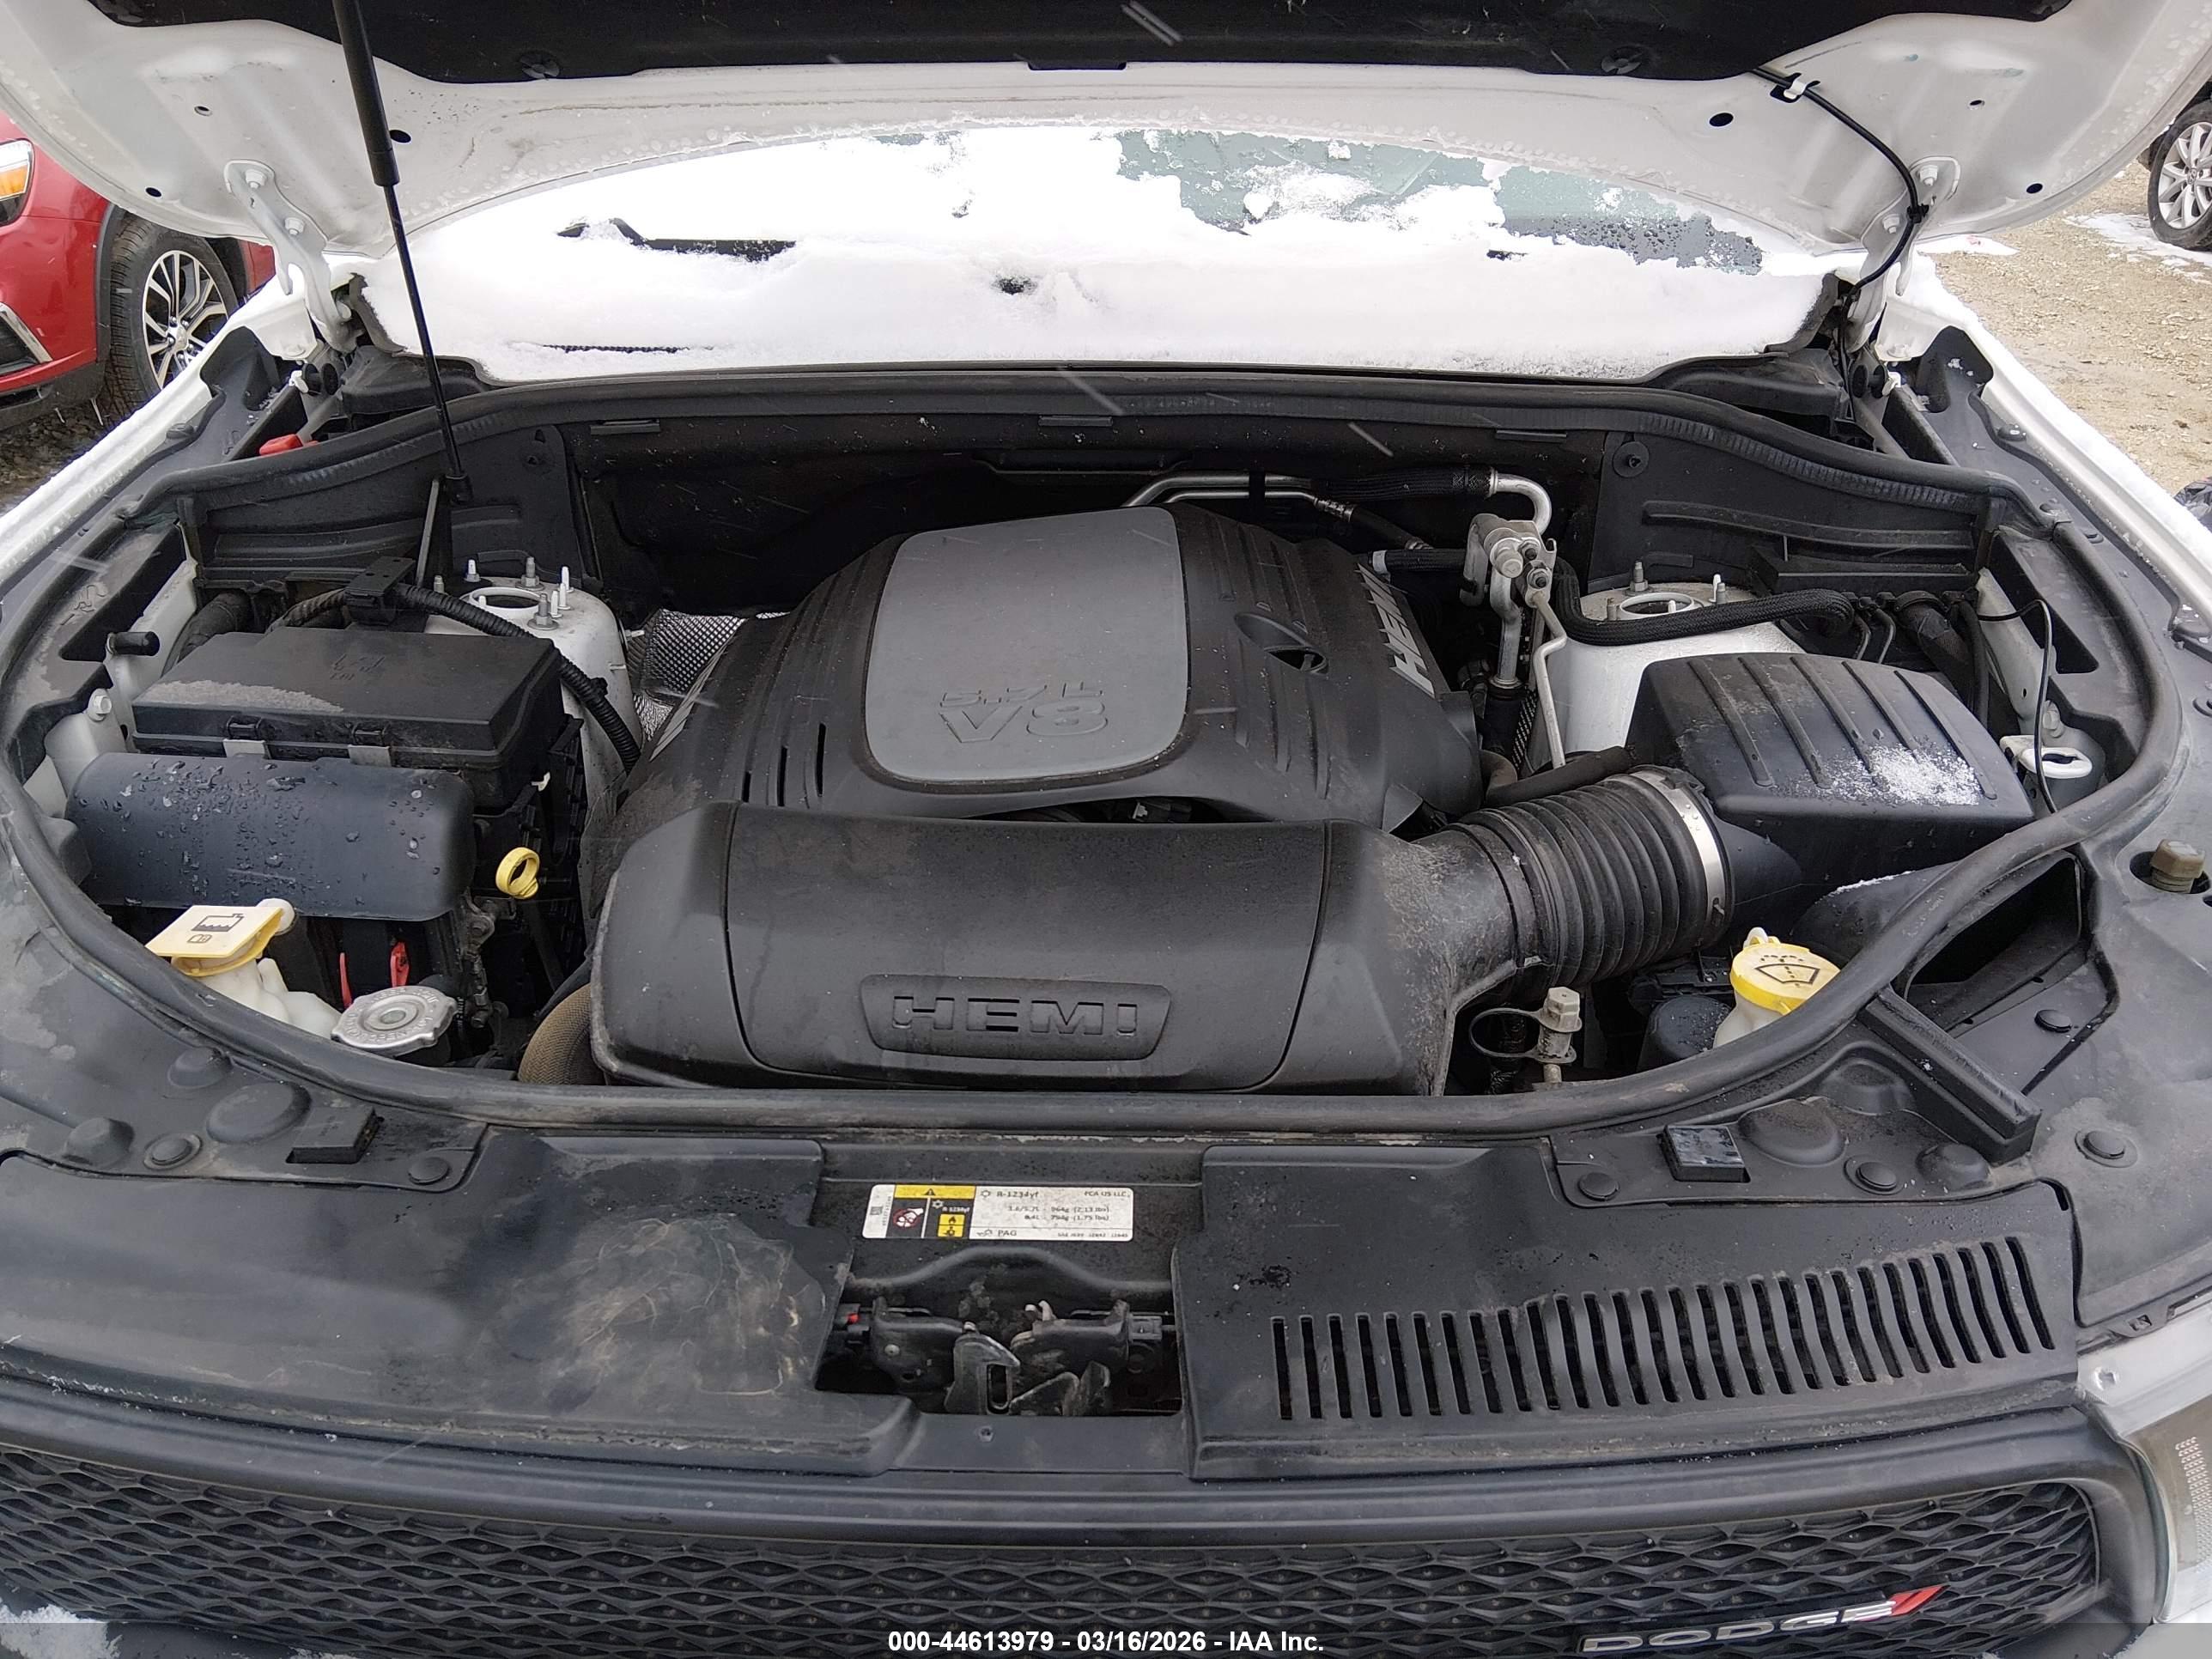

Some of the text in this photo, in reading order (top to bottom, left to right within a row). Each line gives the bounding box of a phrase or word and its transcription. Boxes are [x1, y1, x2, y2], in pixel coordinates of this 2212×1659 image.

[938, 700, 1109, 744] V8
[892, 995, 1137, 1037] HEMI
[1581, 1600, 1896, 1652] DODGE
